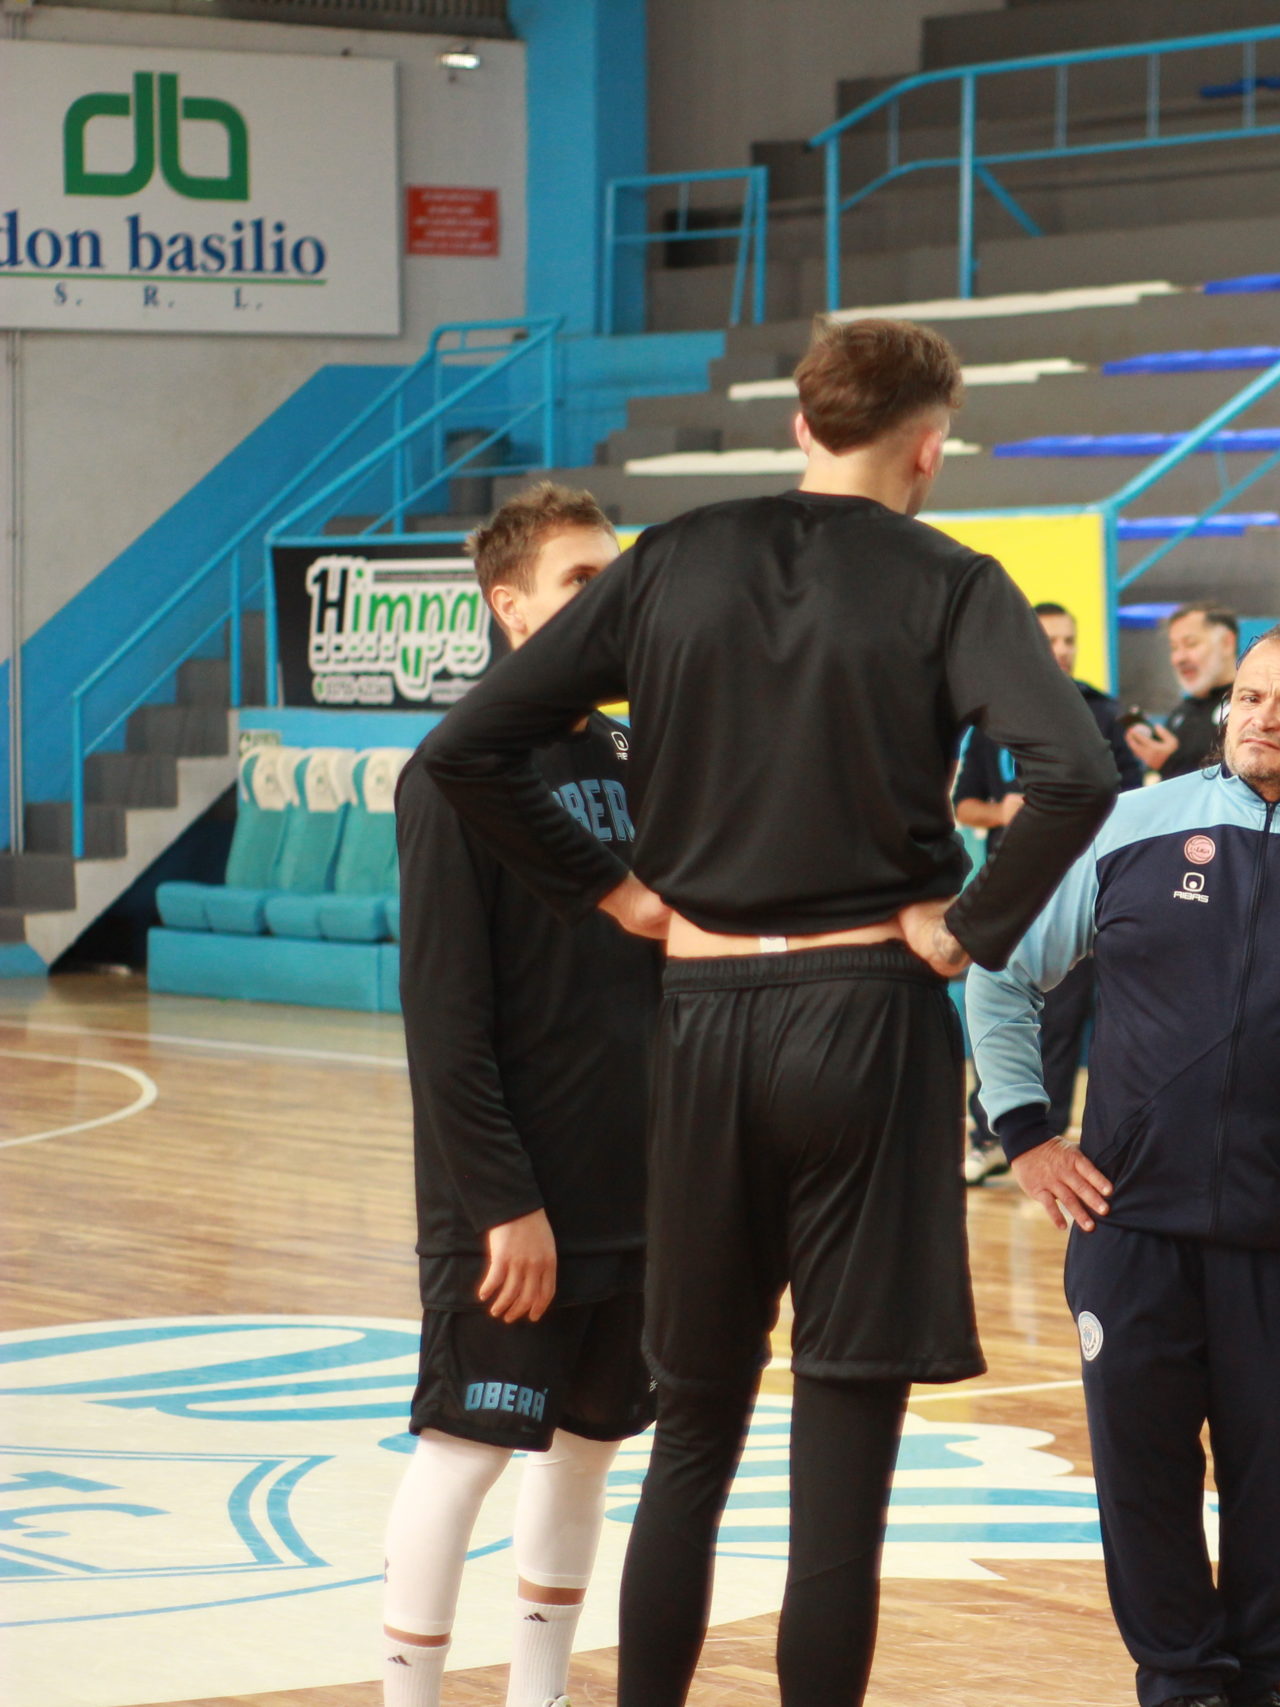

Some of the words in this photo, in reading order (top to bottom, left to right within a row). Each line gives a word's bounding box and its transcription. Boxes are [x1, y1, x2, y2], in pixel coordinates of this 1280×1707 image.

[126, 212, 326, 276] basilio
[551, 779, 636, 842] BER
[464, 1382, 548, 1422] OBERÁ
